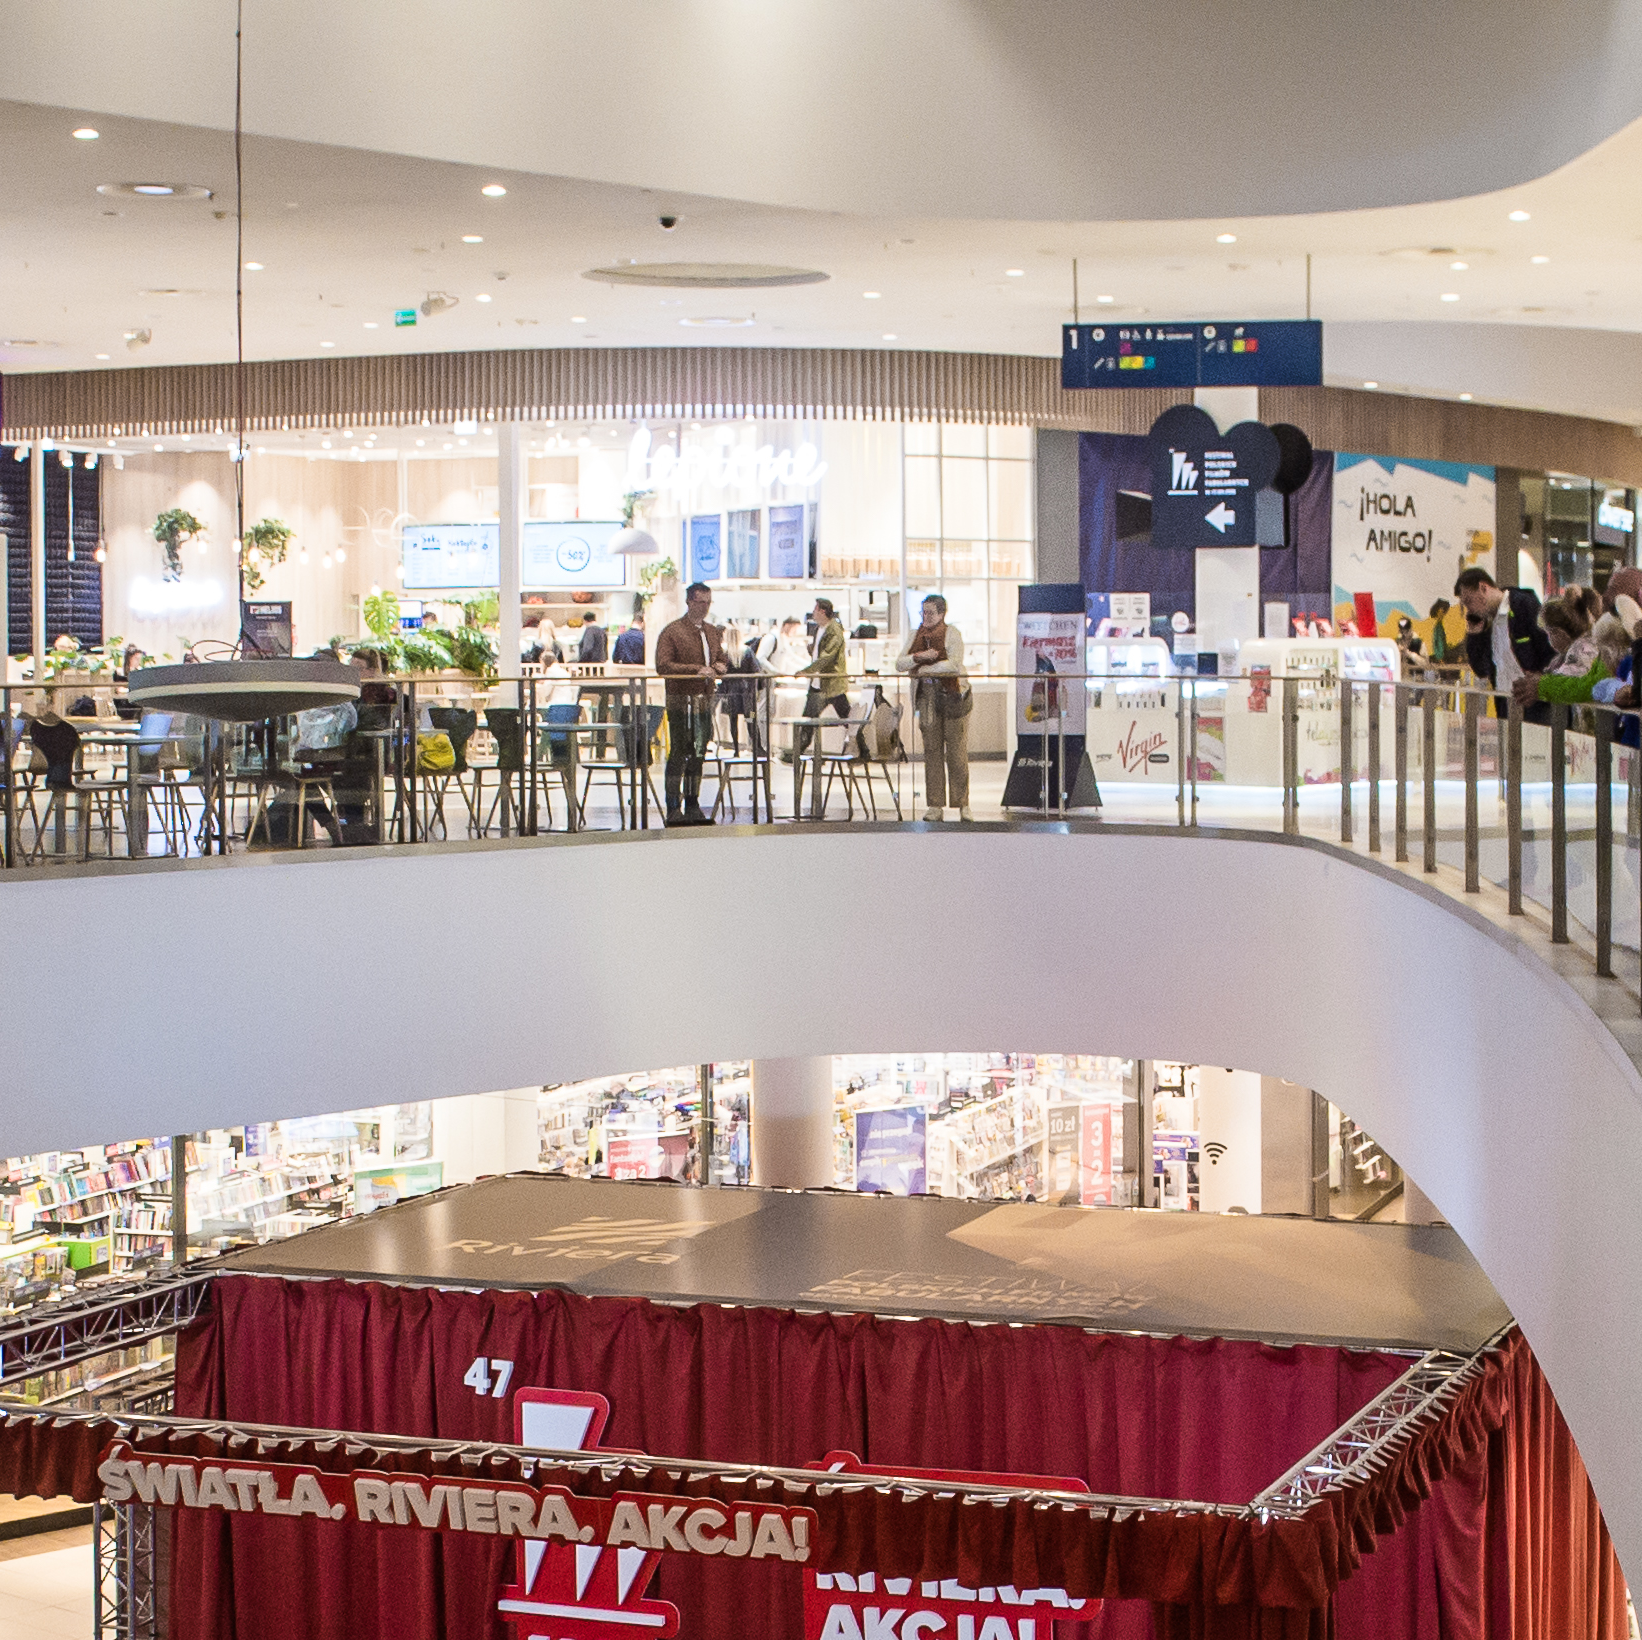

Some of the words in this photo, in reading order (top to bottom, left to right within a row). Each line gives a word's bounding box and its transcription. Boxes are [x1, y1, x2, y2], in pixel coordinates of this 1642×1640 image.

[1359, 486, 1417, 522] ¡HOLA
[1365, 528, 1434, 563] AMIGO!
[1117, 720, 1168, 776] Virgin
[1050, 1117, 1064, 1134] 10
[435, 1238, 682, 1265] Riviera
[463, 1357, 514, 1398] 47
[98, 1444, 346, 1520] ŚWIATŁA.
[354, 1478, 595, 1544] RIVIERA.
[606, 1499, 811, 1564] AKCJA!
